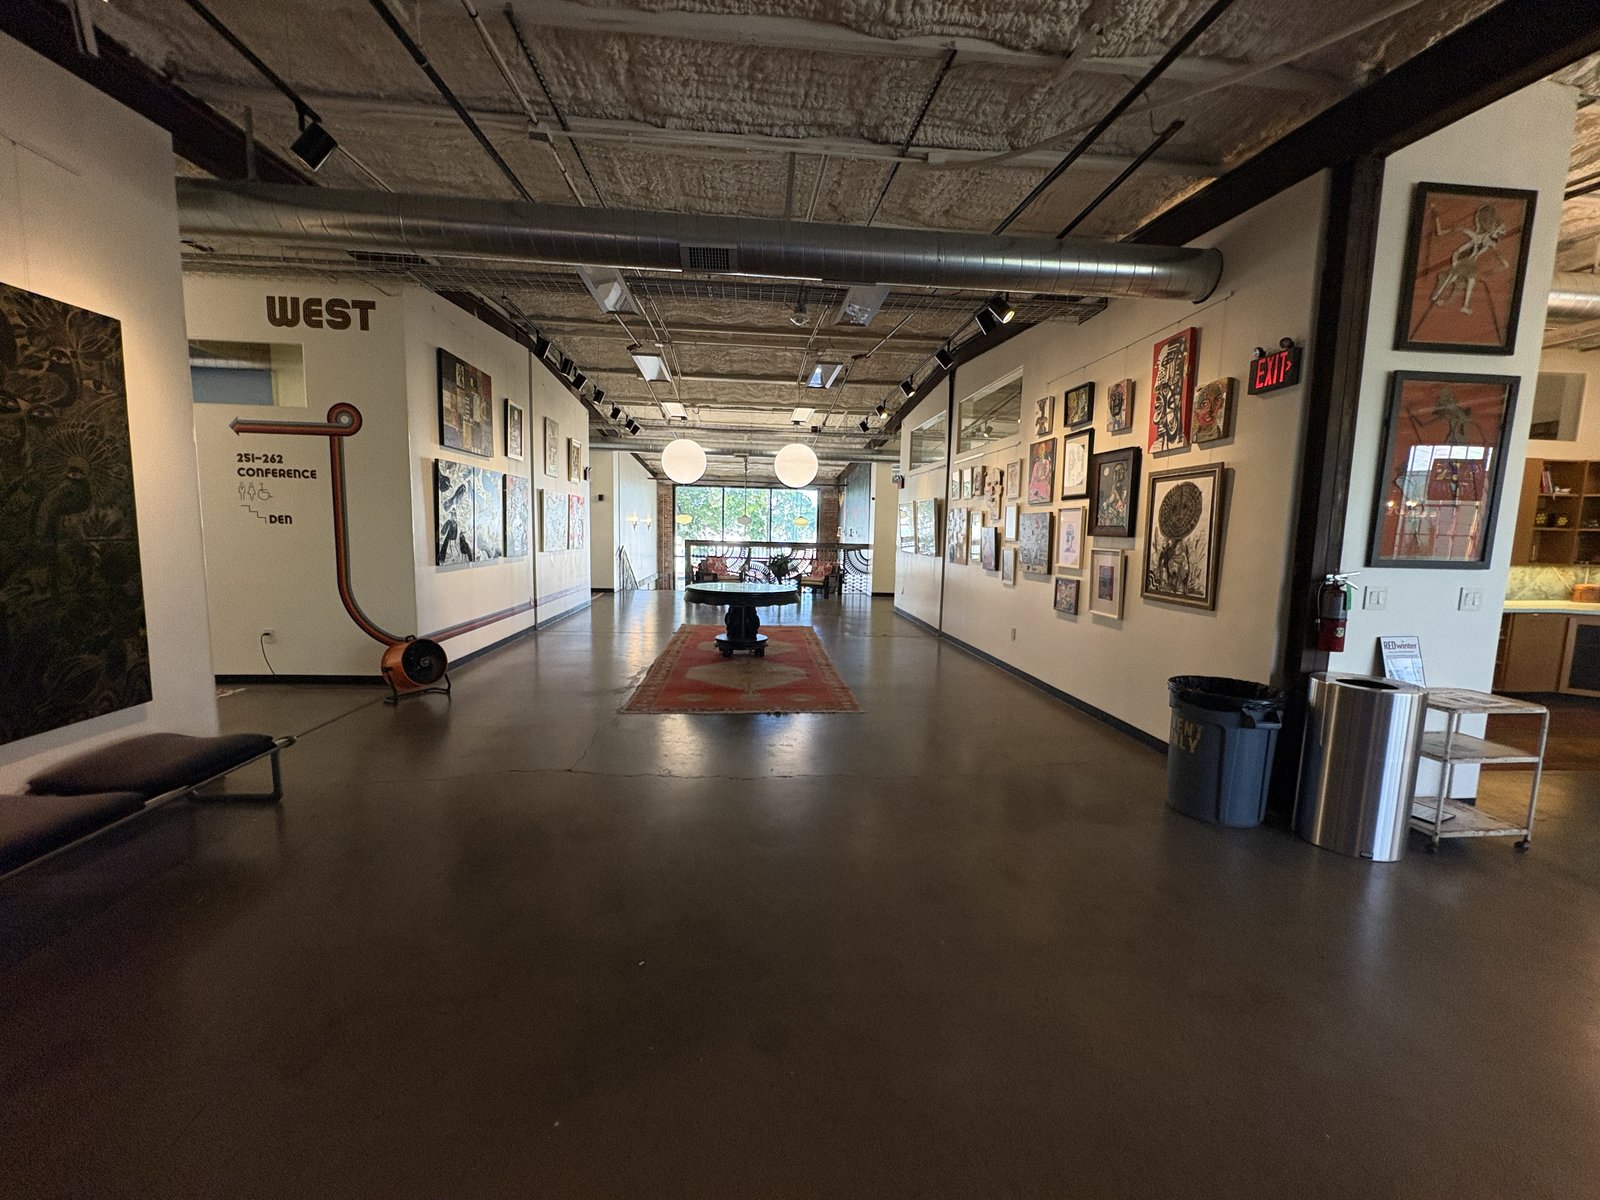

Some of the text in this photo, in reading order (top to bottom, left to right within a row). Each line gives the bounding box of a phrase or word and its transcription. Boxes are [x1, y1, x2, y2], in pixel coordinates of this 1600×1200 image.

[266, 295, 376, 331] WEST
[1255, 351, 1289, 389] EXIT
[236, 453, 284, 464] 251-262
[237, 467, 317, 479] CONFERENCE
[269, 514, 293, 525] DEN
